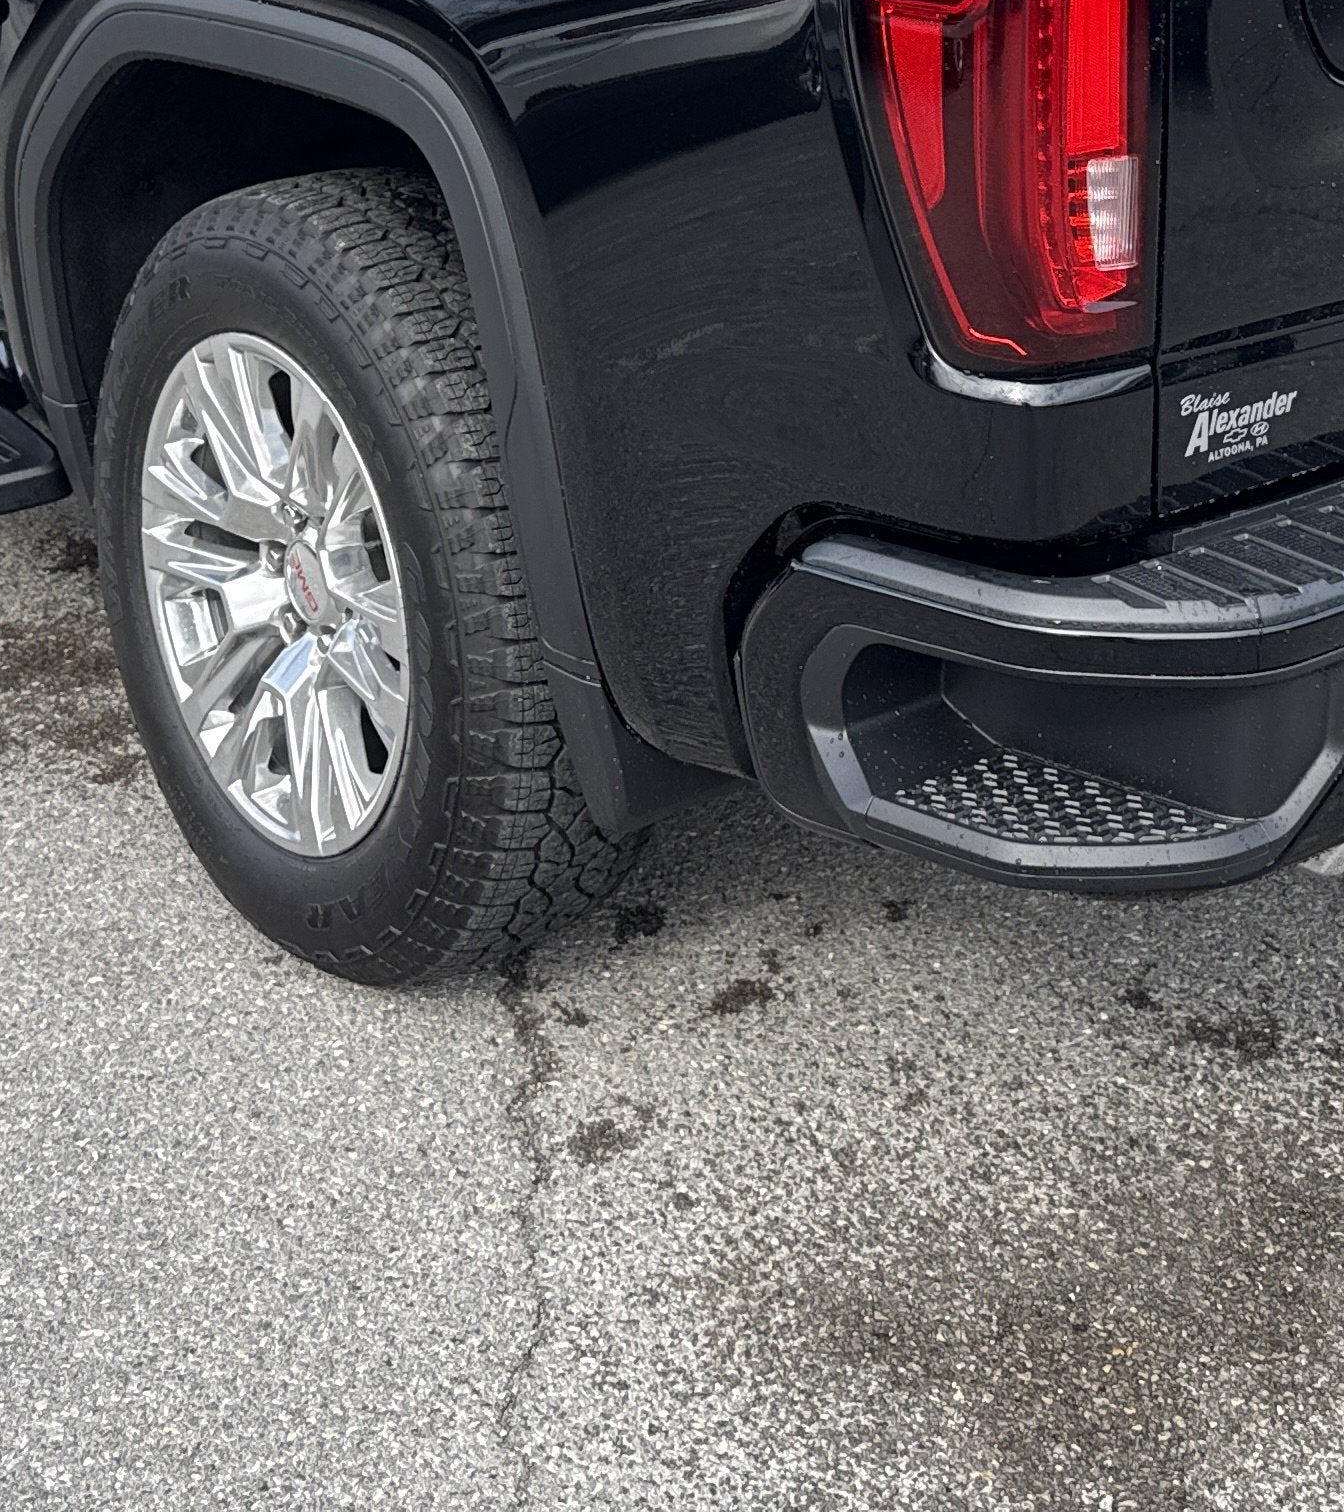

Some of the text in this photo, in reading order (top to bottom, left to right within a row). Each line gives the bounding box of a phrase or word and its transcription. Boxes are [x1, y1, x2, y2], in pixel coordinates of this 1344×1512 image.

[1180, 391, 1232, 417] Blaise
[1184, 390, 1298, 458] Alexander
[1207, 434, 1269, 463] ALTOONA, PA
[290, 551, 319, 613] GMC
